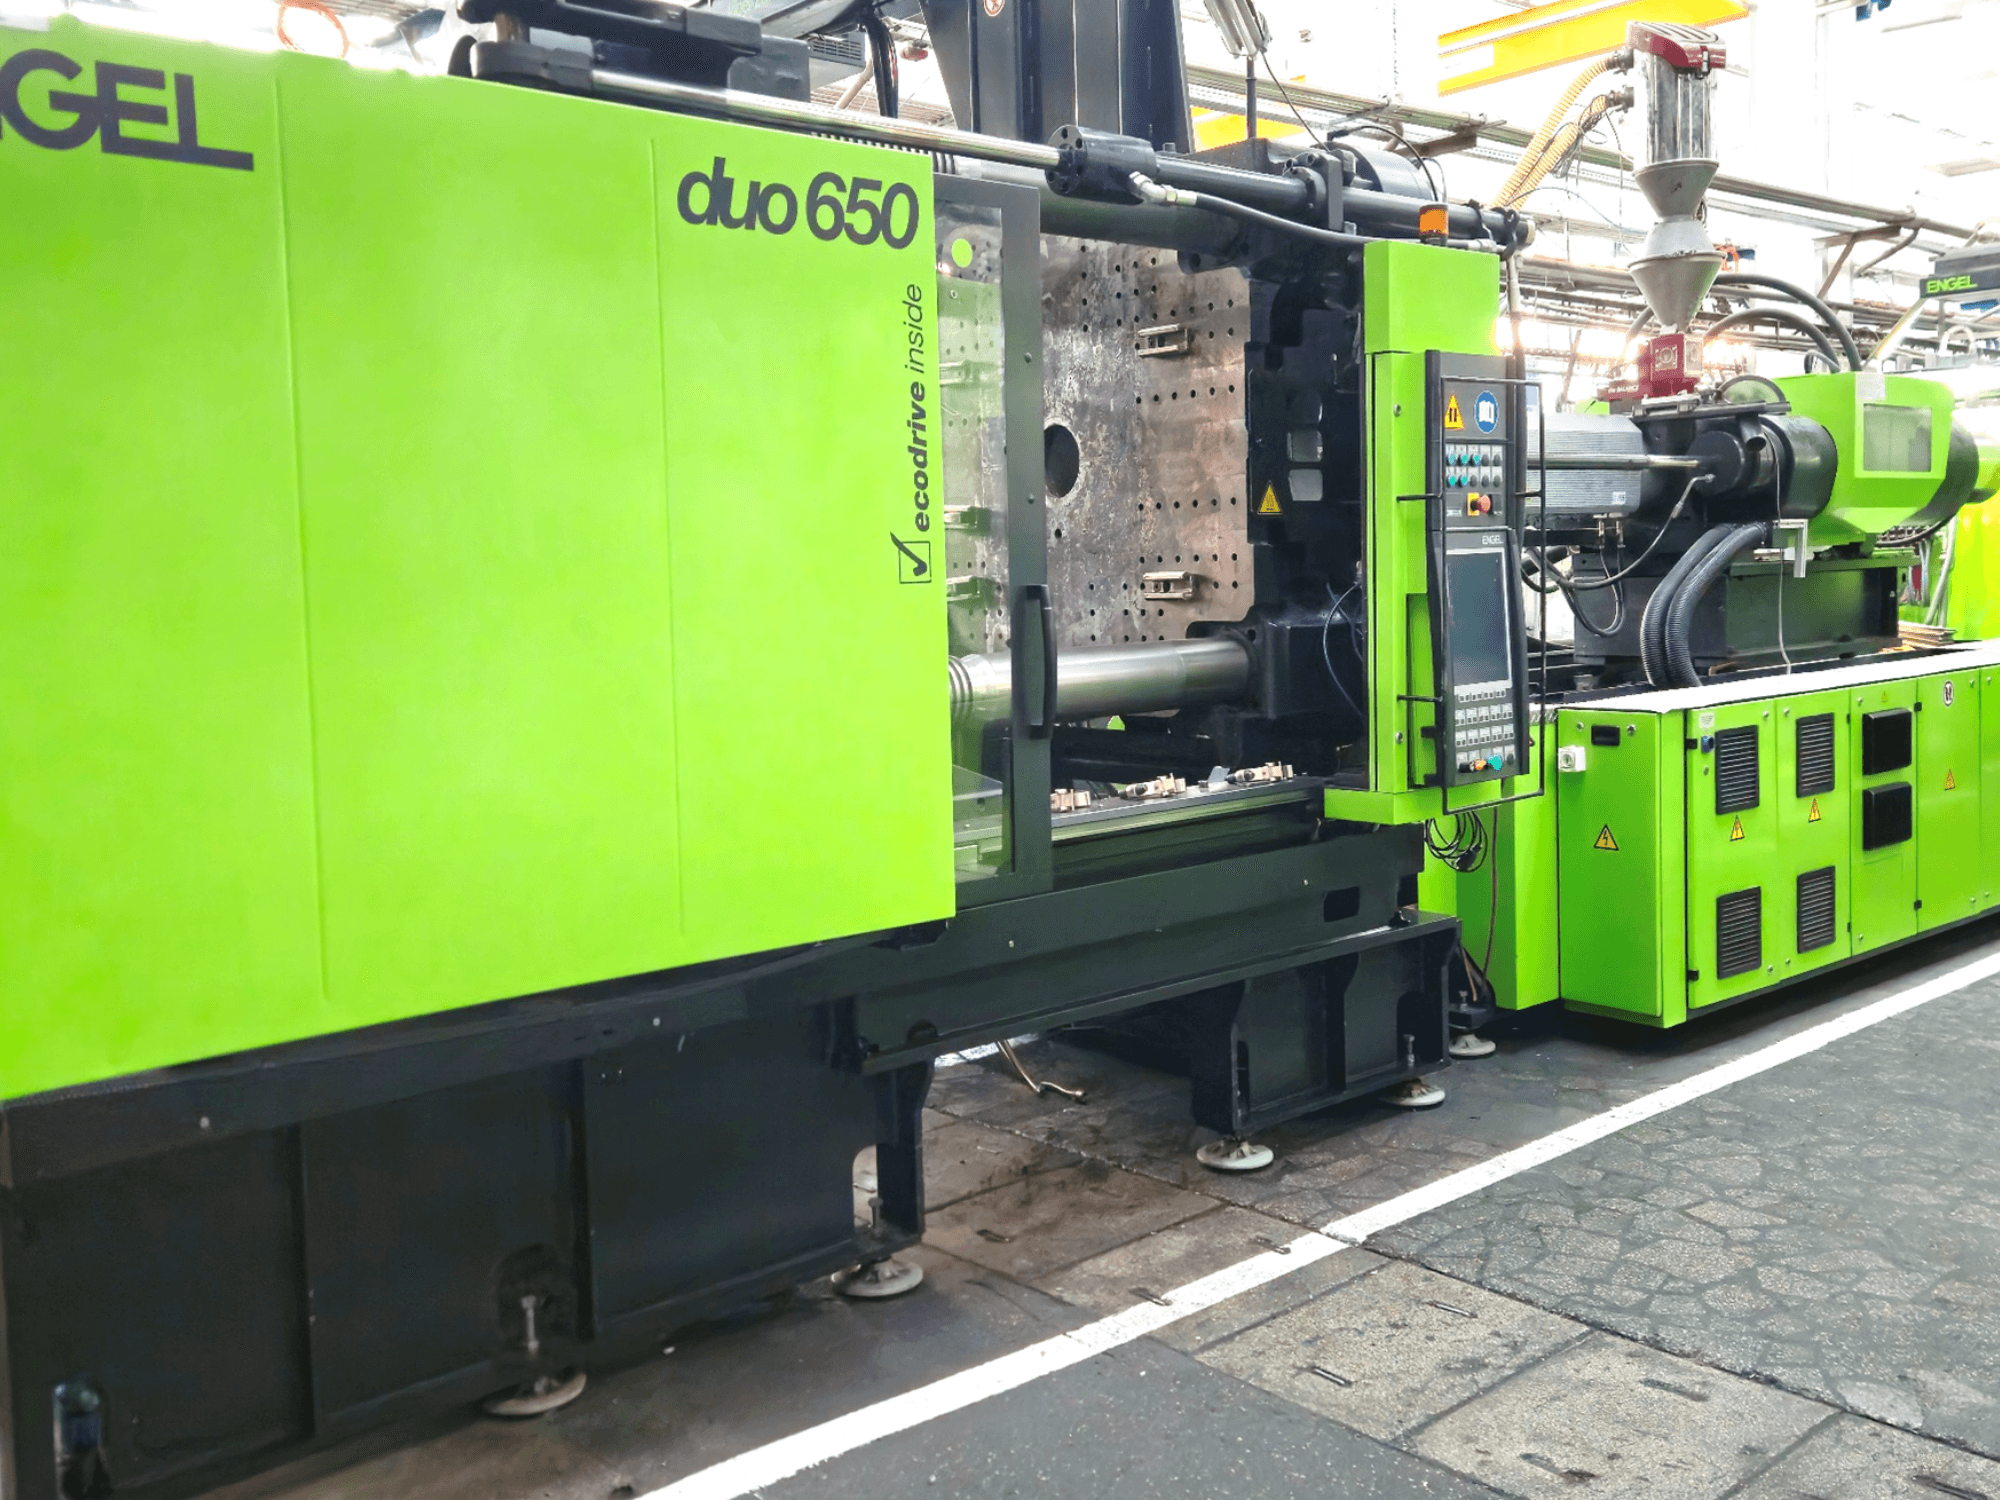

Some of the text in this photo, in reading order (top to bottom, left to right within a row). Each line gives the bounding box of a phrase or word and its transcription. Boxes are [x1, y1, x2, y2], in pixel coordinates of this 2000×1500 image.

[0, 48, 254, 172] GEL
[677, 156, 920, 250] duo 650
[1926, 275, 1978, 294] ENGEL
[902, 283, 930, 532] ecodrive inside
